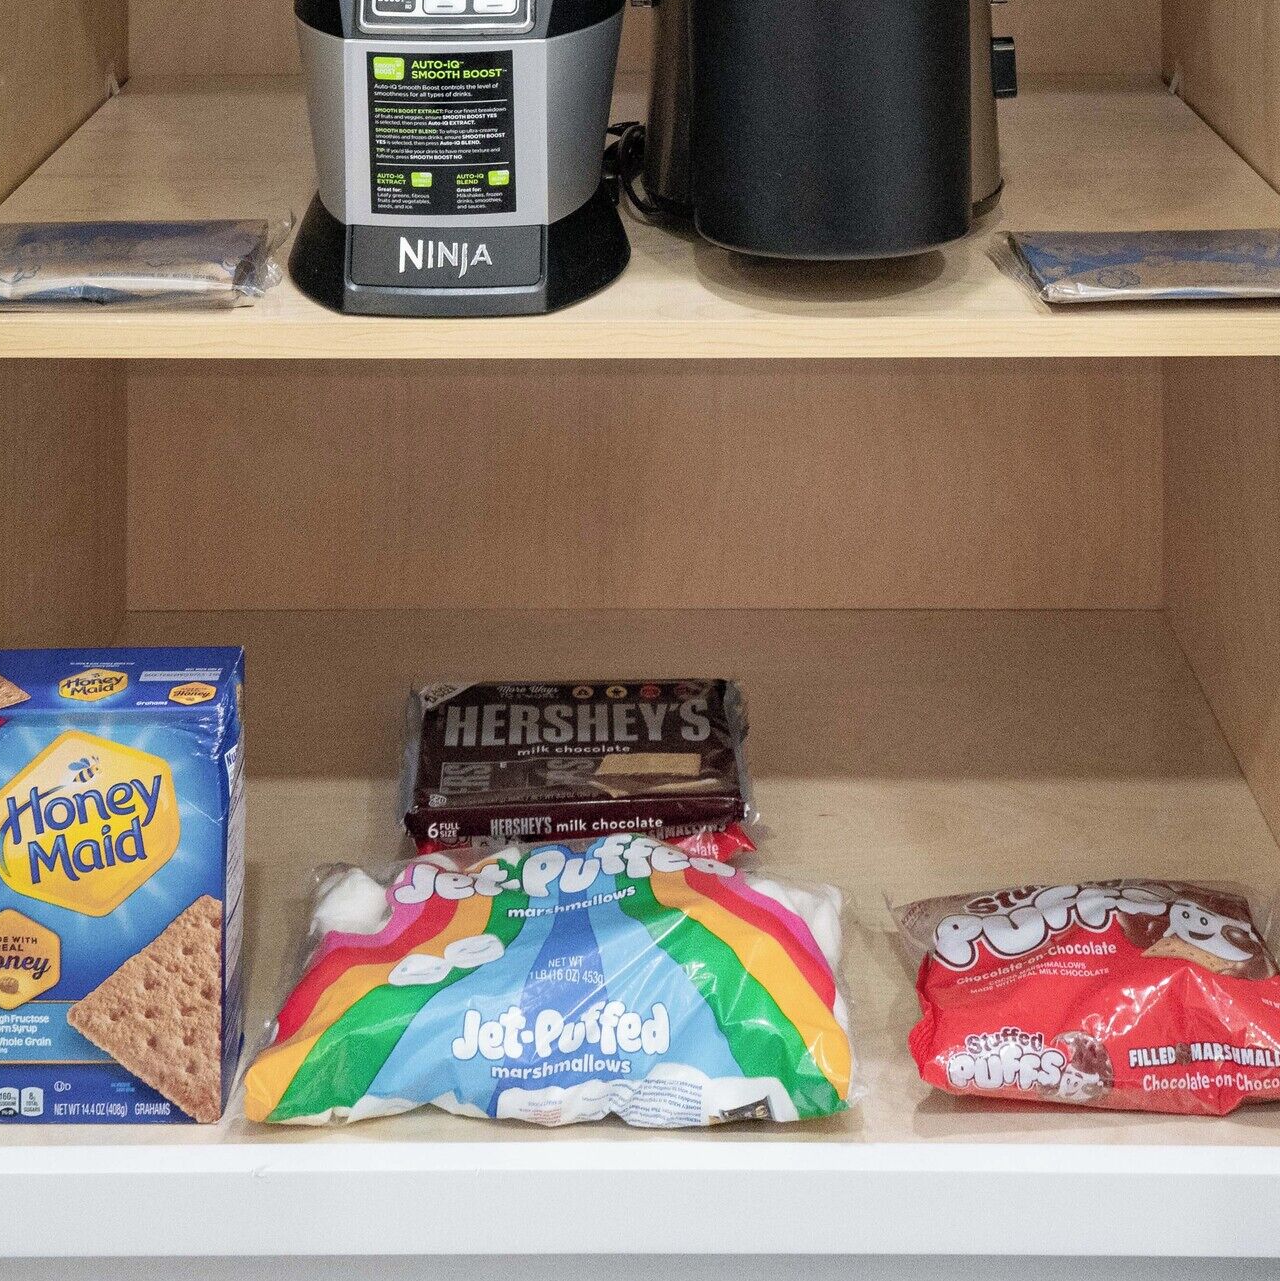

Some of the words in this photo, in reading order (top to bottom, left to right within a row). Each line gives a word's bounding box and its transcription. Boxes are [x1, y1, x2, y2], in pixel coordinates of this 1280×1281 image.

[411, 60, 460, 69] AUTO-iQ
[412, 70, 460, 79] SMOOTH
[463, 68, 502, 79] BOOST
[399, 236, 493, 278] NINJA
[61, 676, 124, 689] Honey
[70, 683, 114, 696] Maid
[497, 685, 526, 694] More
[529, 685, 560, 694] Ways
[174, 690, 211, 698] Honey
[444, 698, 711, 747] HERSHEY'S
[518, 745, 550, 756] milk
[555, 745, 631, 754] chocolate
[0, 774, 162, 852] Honey
[428, 822, 439, 838] 6
[440, 822, 460, 830] FULL
[490, 817, 552, 836] HERSHEY'S
[557, 819, 586, 832] milk
[592, 818, 663, 832] chocolate
[439, 830, 458, 838] SIZE
[27, 815, 148, 885] Maid
[507, 885, 636, 919] marshmallows
[12, 936, 38, 944] WITH
[548, 958, 566, 968] NET
[569, 956, 584, 968] WT
[956, 941, 1118, 986] Chocolate-on-Chocolate
[565, 969, 580, 983] OZ)
[582, 971, 605, 986] 453g
[995, 977, 1016, 989] WITH
[1038, 968, 1058, 977] MILK
[1060, 967, 1110, 978] CHOCOLATE
[11, 1014, 50, 1023] Fructose
[12, 1024, 38, 1034] Syrup
[451, 1000, 671, 1061] Jet-Puffed
[25, 1036, 52, 1047] Grain
[966, 1027, 1043, 1054] Stuffed
[1128, 1046, 1176, 1068] FILLED
[491, 1053, 632, 1081] marshmallows
[54, 1103, 67, 1116] NET
[68, 1103, 80, 1116] WT
[81, 1103, 95, 1116] 14.4
[95, 1103, 106, 1116] OZ
[106, 1102, 128, 1118] (408g)
[134, 1103, 171, 1116] GRAHAMS
